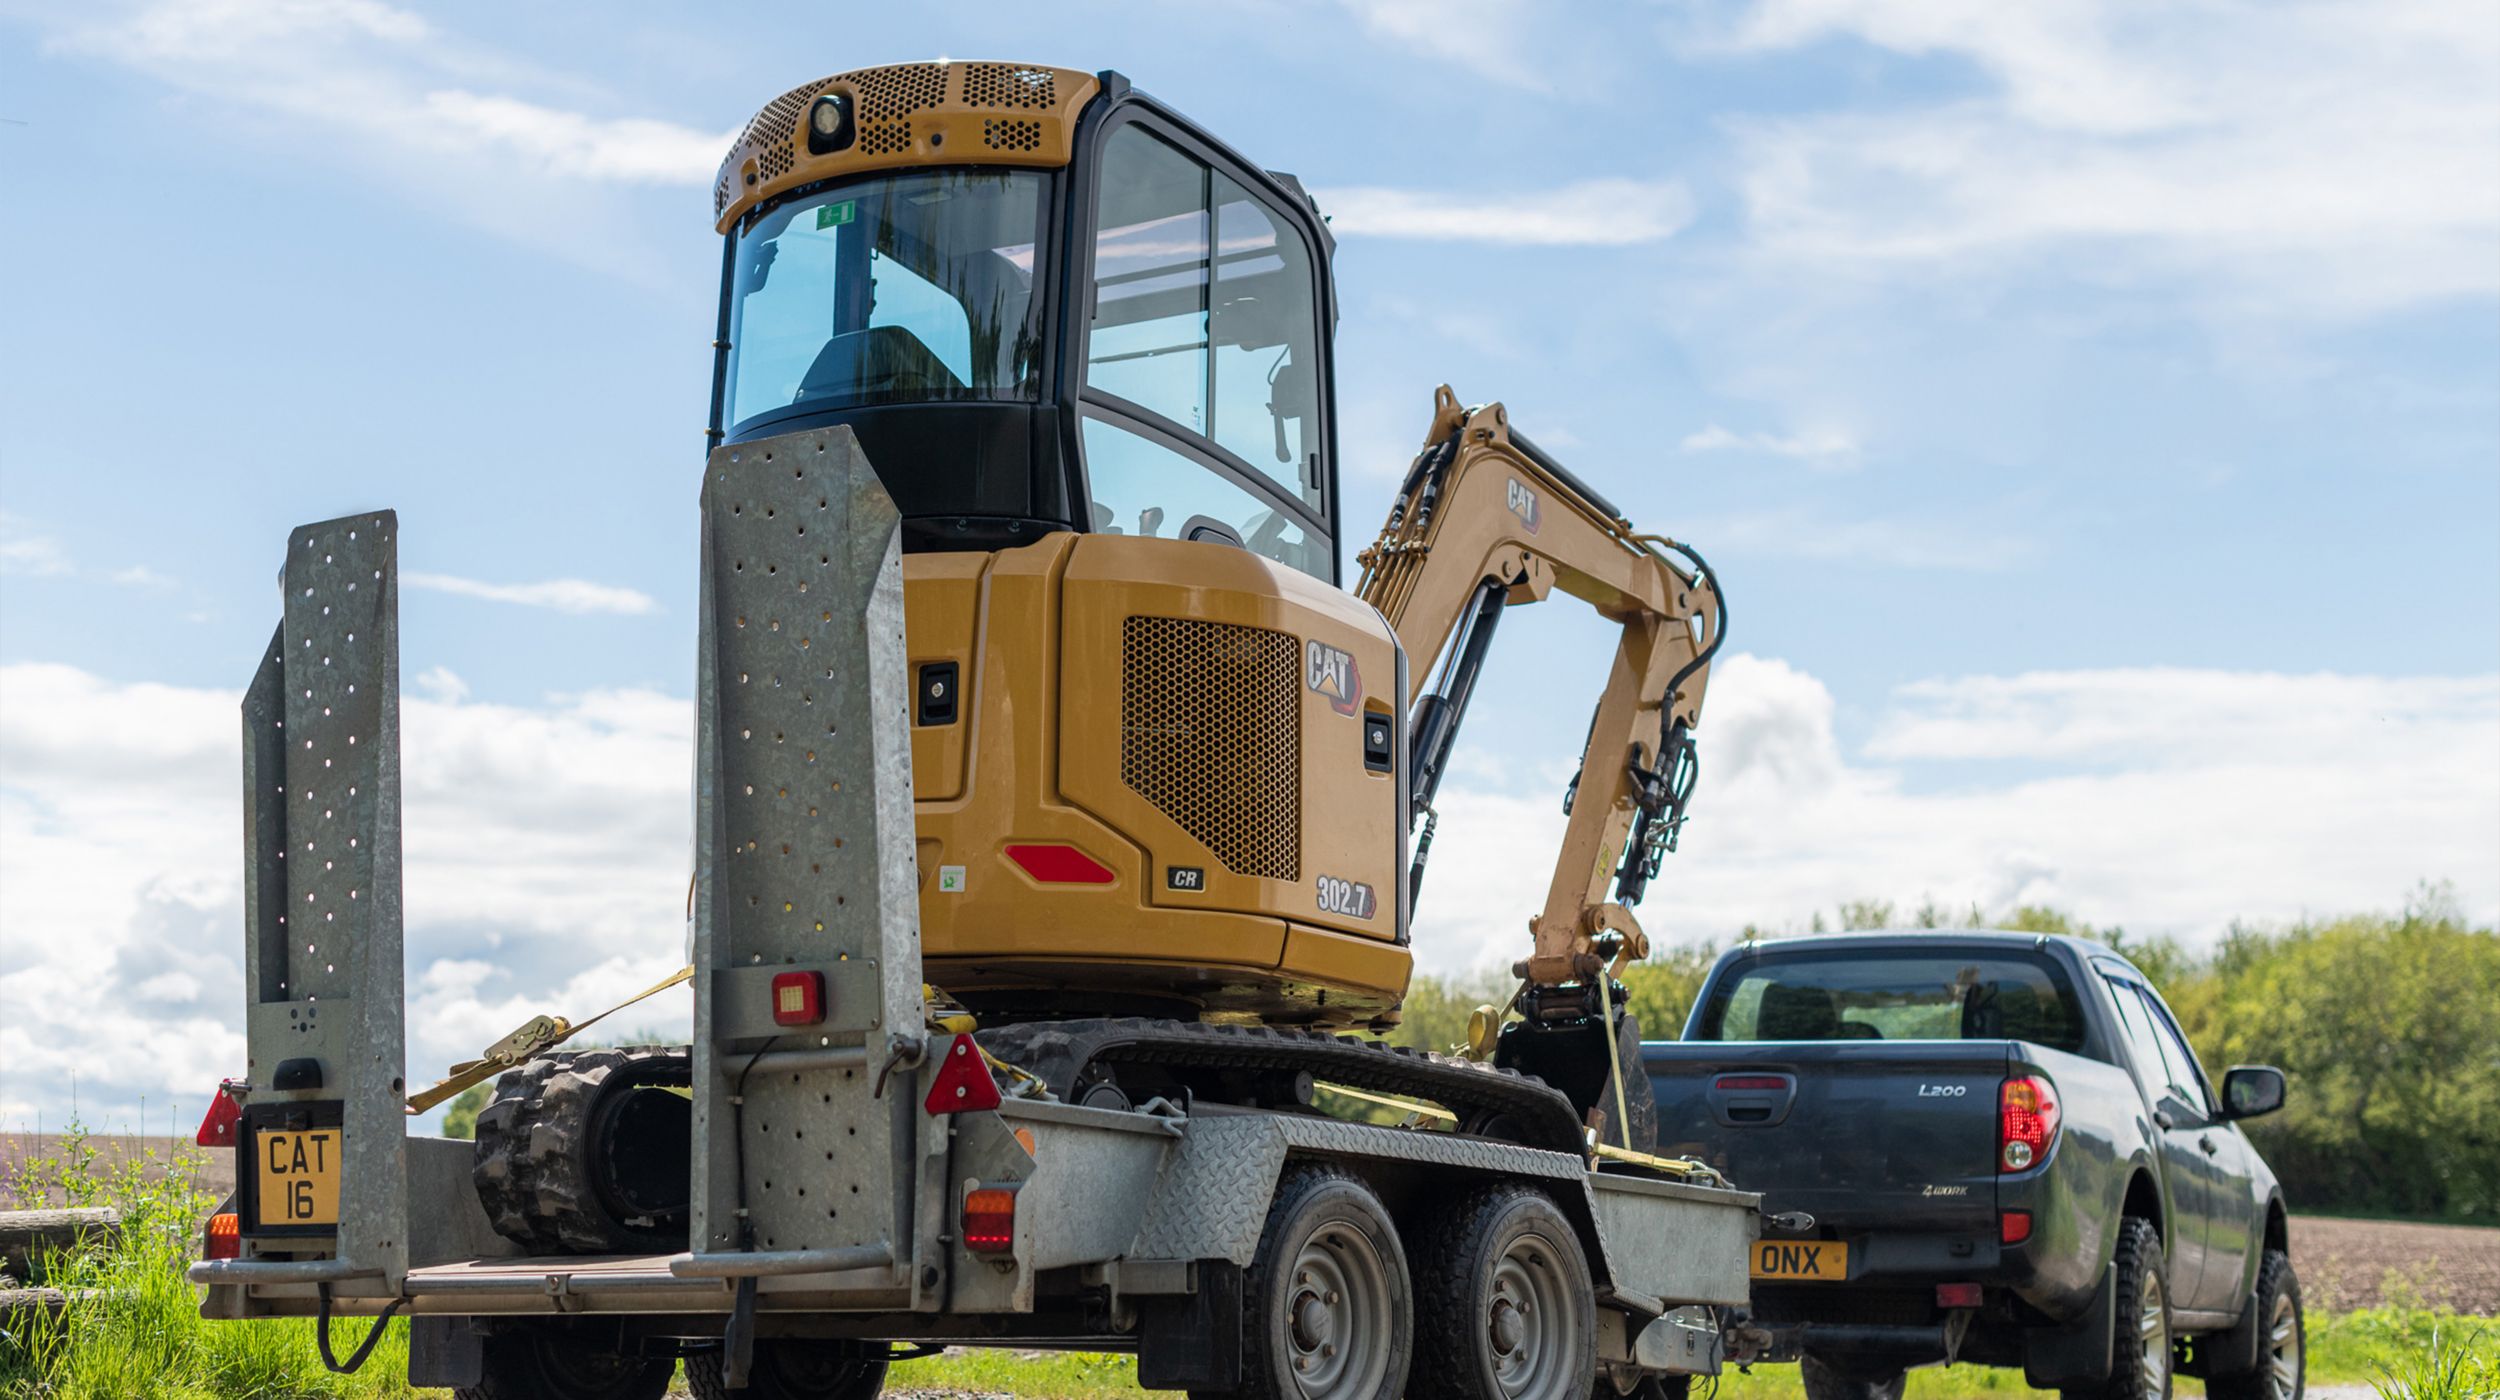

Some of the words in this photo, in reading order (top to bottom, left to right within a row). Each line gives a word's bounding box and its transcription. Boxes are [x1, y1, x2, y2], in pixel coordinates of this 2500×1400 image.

[1507, 478, 1536, 523] CAT
[1307, 641, 1350, 700] CAT
[1174, 870, 1197, 887] CR
[1317, 876, 1367, 916] 302.7
[1918, 1084, 1967, 1097] L200
[269, 1135, 330, 1174] CAT
[287, 1180, 314, 1219] 16
[1761, 1245, 1821, 1274] ONX
